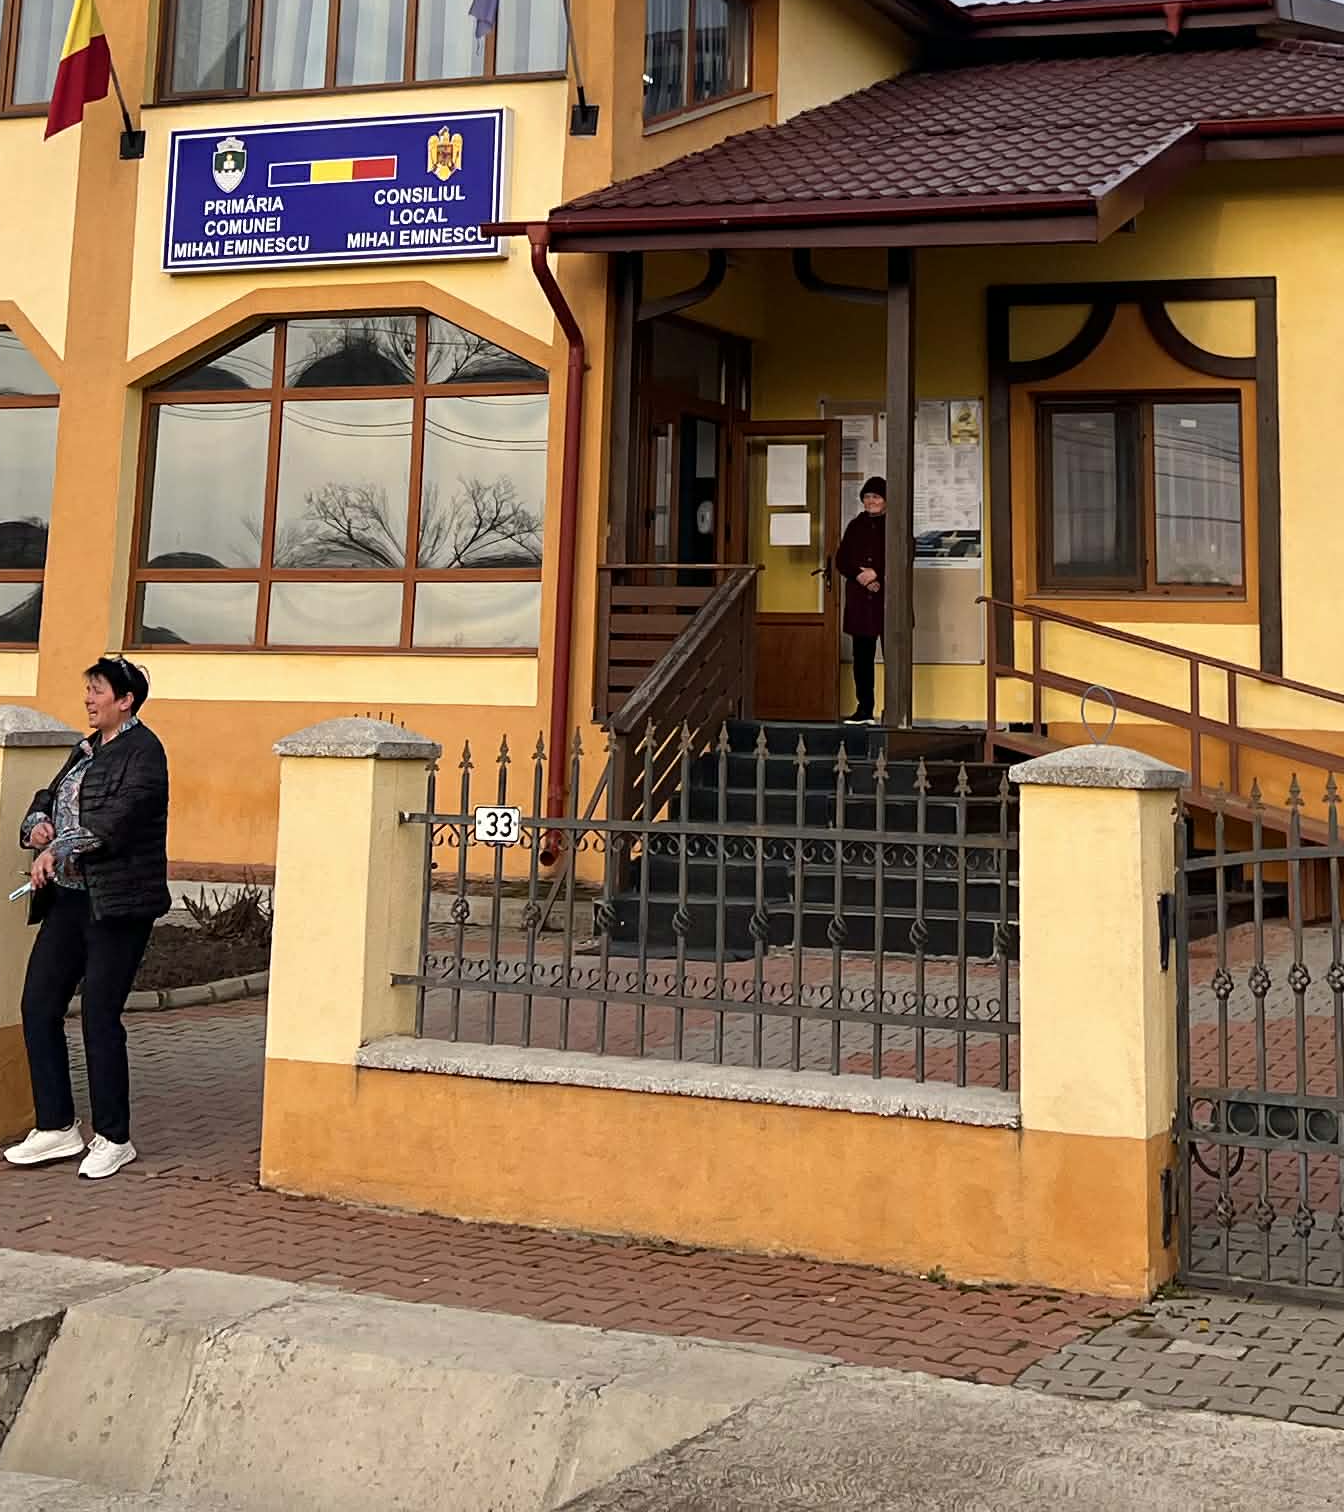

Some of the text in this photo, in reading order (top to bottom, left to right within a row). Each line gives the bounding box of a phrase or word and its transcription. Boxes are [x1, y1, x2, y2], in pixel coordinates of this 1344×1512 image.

[374, 185, 465, 204] CONSILIUL
[390, 208, 448, 225] LOCAL
[204, 217, 281, 236] COMUNEI
[174, 236, 309, 258] MIHAI EMINESCU
[347, 231, 394, 248] MIHAI
[486, 812, 512, 837] 33
